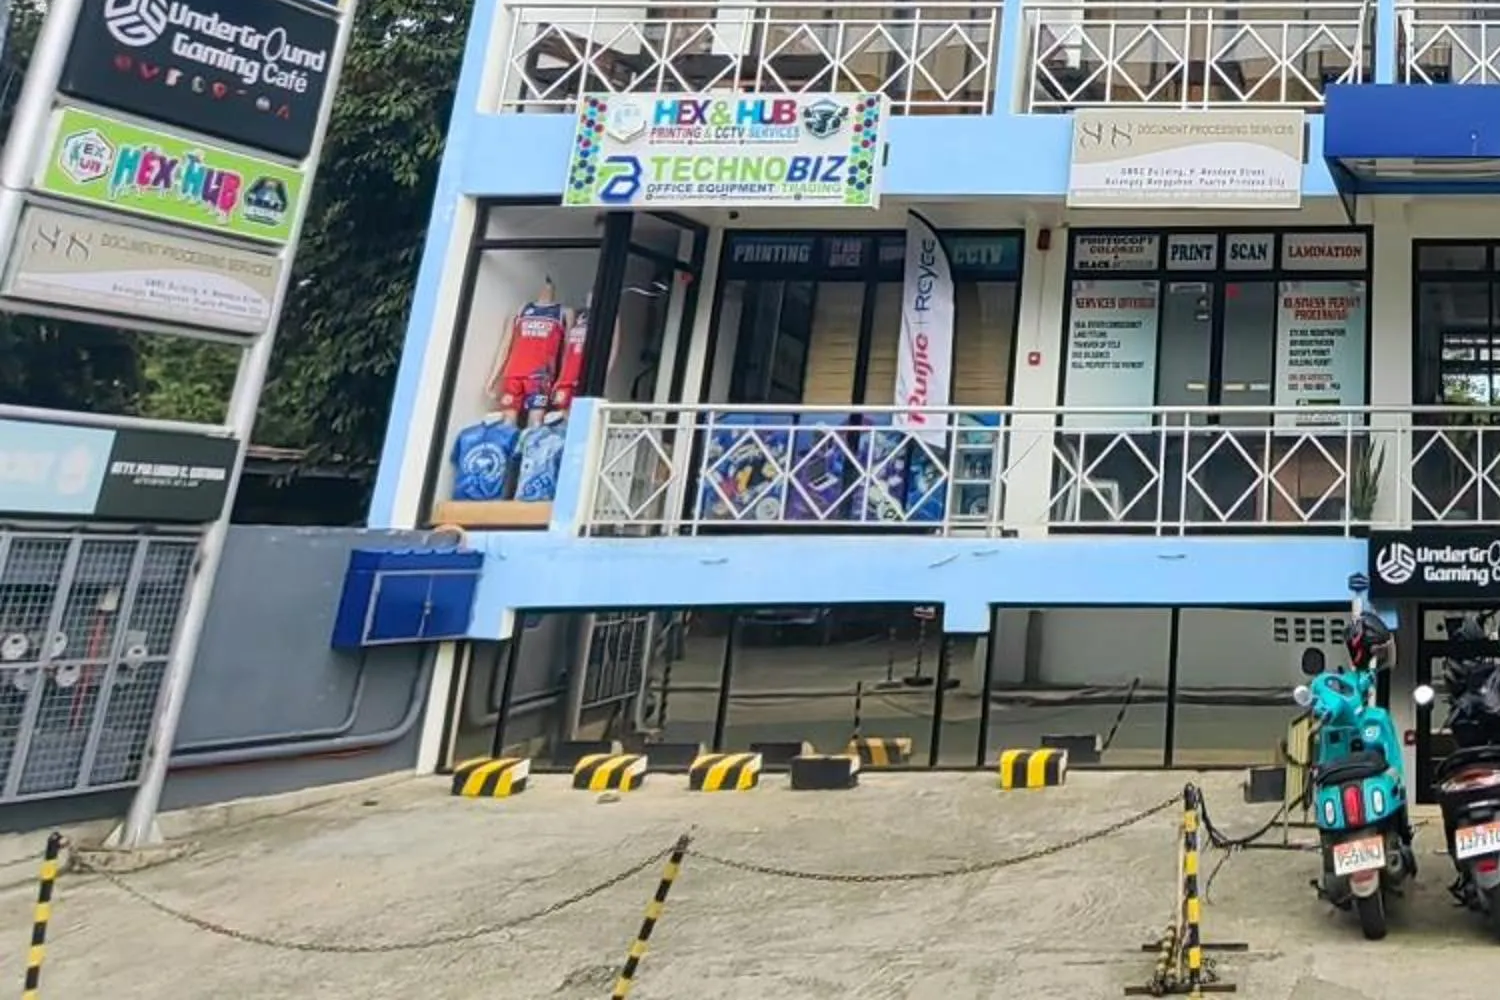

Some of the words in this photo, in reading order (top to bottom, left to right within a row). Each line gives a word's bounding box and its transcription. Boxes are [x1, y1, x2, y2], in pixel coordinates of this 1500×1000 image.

[172, 32, 261, 84] Gaming
[262, 63, 308, 93] Café
[653, 100, 712, 125] HEX
[710, 101, 732, 125] &
[735, 100, 798, 125] HUB
[650, 127, 702, 139] PRINTING
[714, 127, 746, 139] CCTV
[651, 156, 848, 183] TECHNOBIZ
[646, 183, 693, 193] OFFICE
[697, 183, 775, 193] EQUIPMENT
[1171, 244, 1213, 261] PRINT
[1230, 243, 1267, 260] SCAN
[1288, 245, 1362, 258] LAMINATION
[1423, 565, 1490, 586] Gaming
